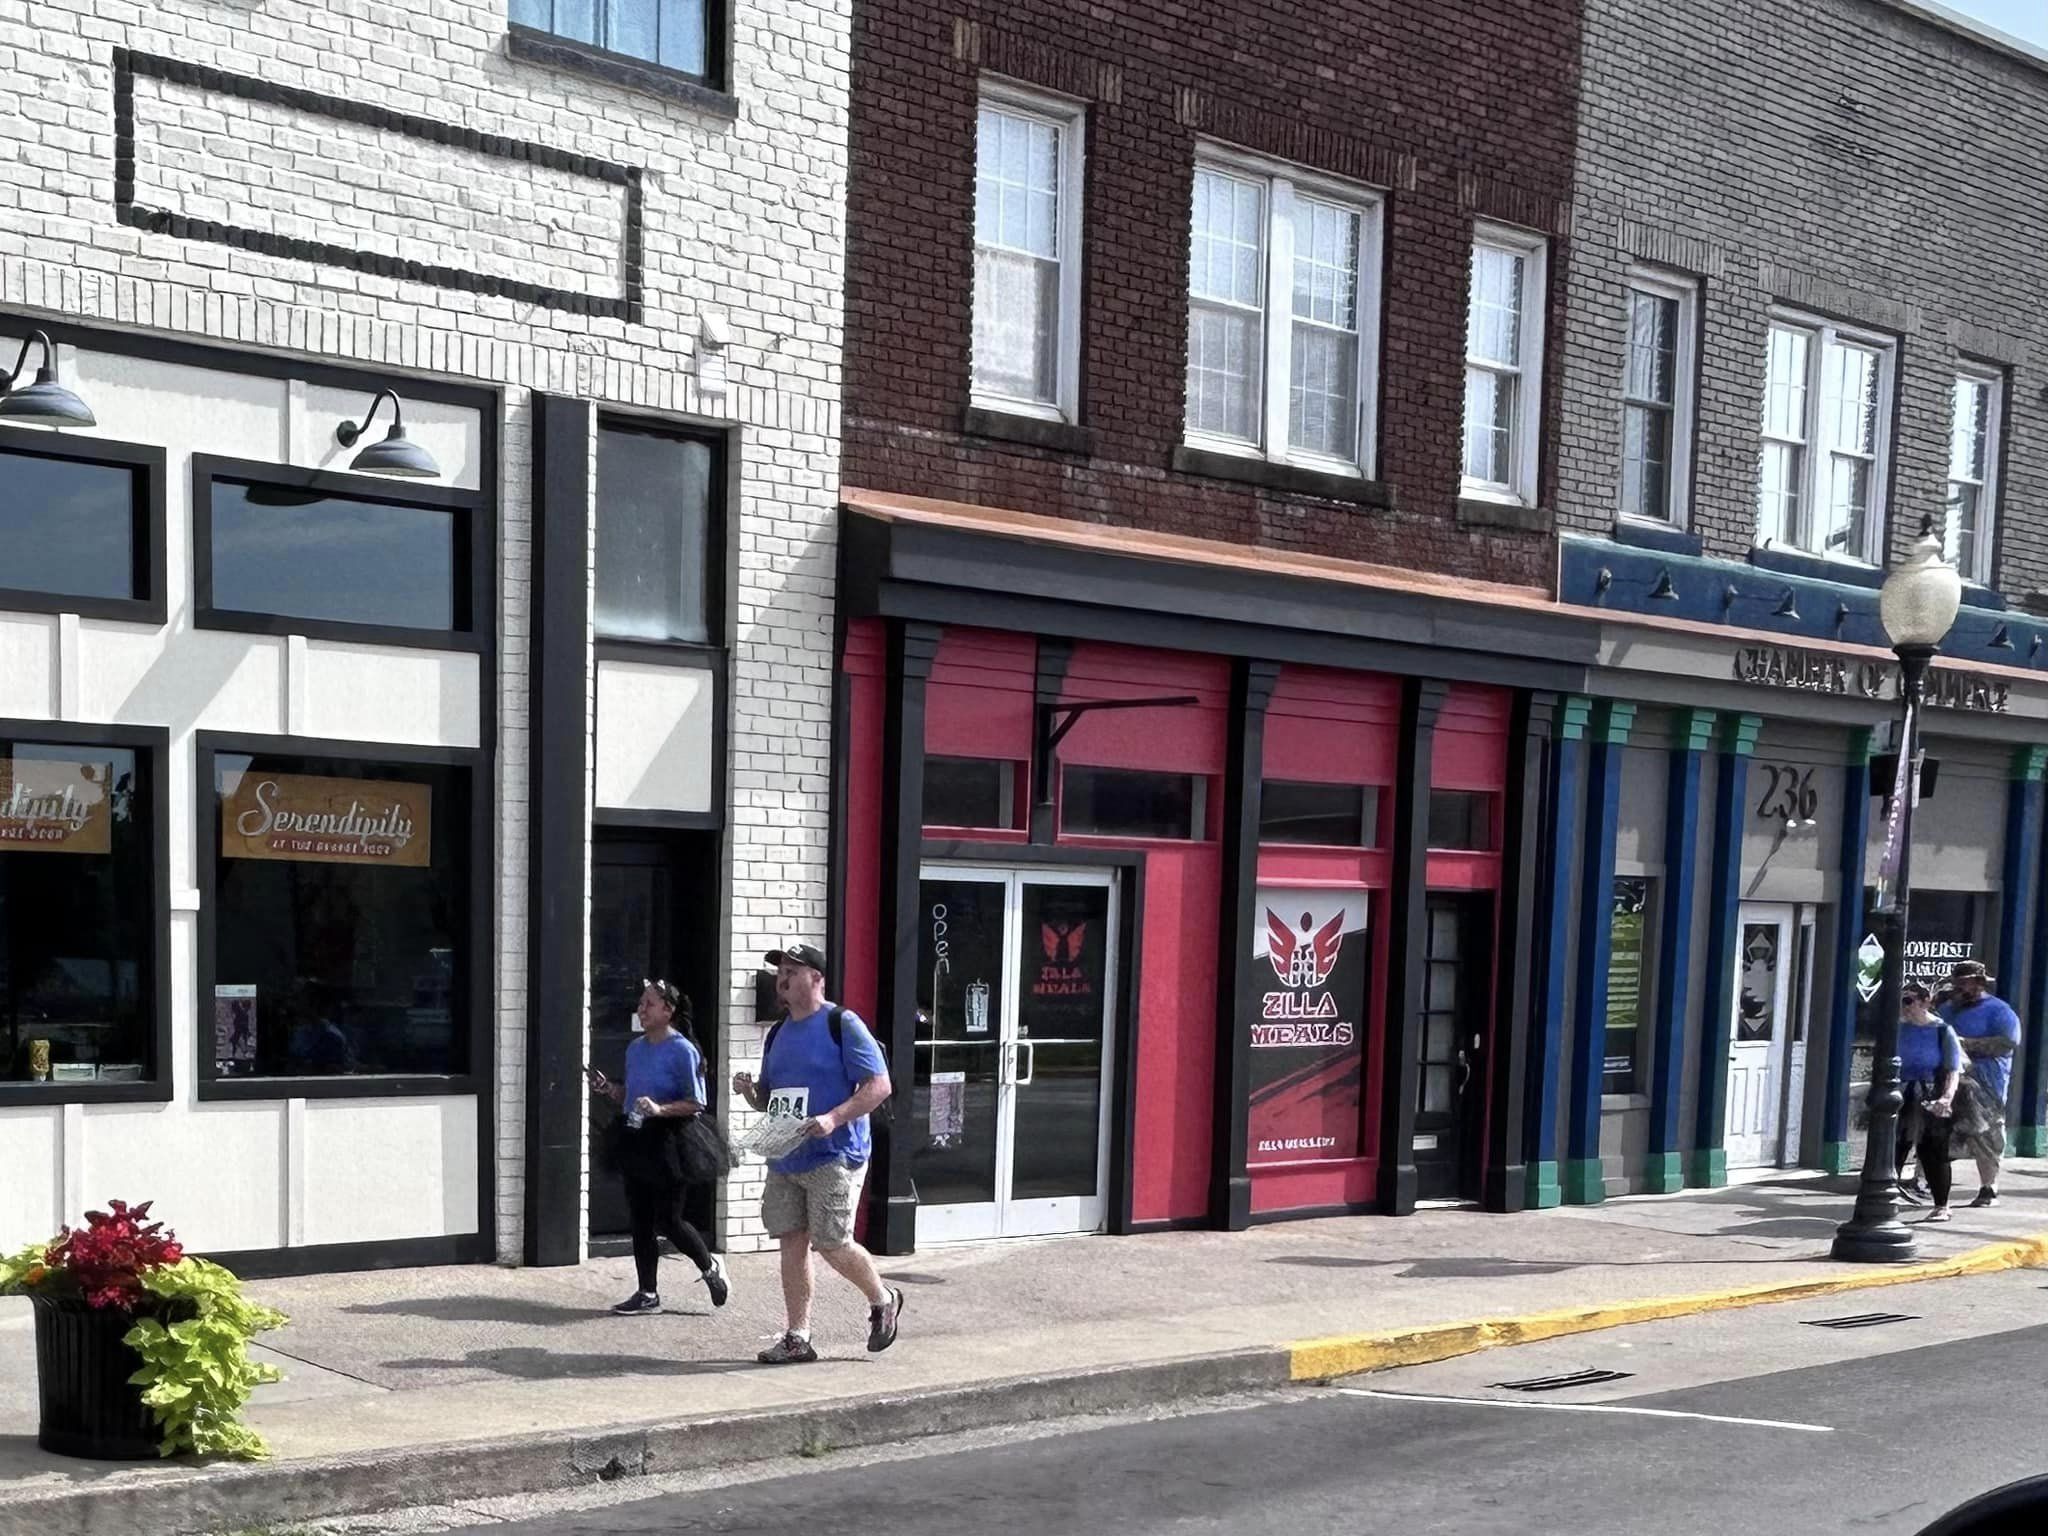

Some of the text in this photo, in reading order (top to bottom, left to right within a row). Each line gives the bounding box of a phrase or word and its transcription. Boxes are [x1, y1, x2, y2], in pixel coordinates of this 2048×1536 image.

[1734, 648, 1850, 696] CHAMBER
[1856, 660, 1888, 699] OF
[237, 780, 416, 848] Serendipity
[1757, 764, 1818, 821] 236
[1262, 991, 1338, 1019] ZILLA
[1250, 1022, 1354, 1048] MEALS
